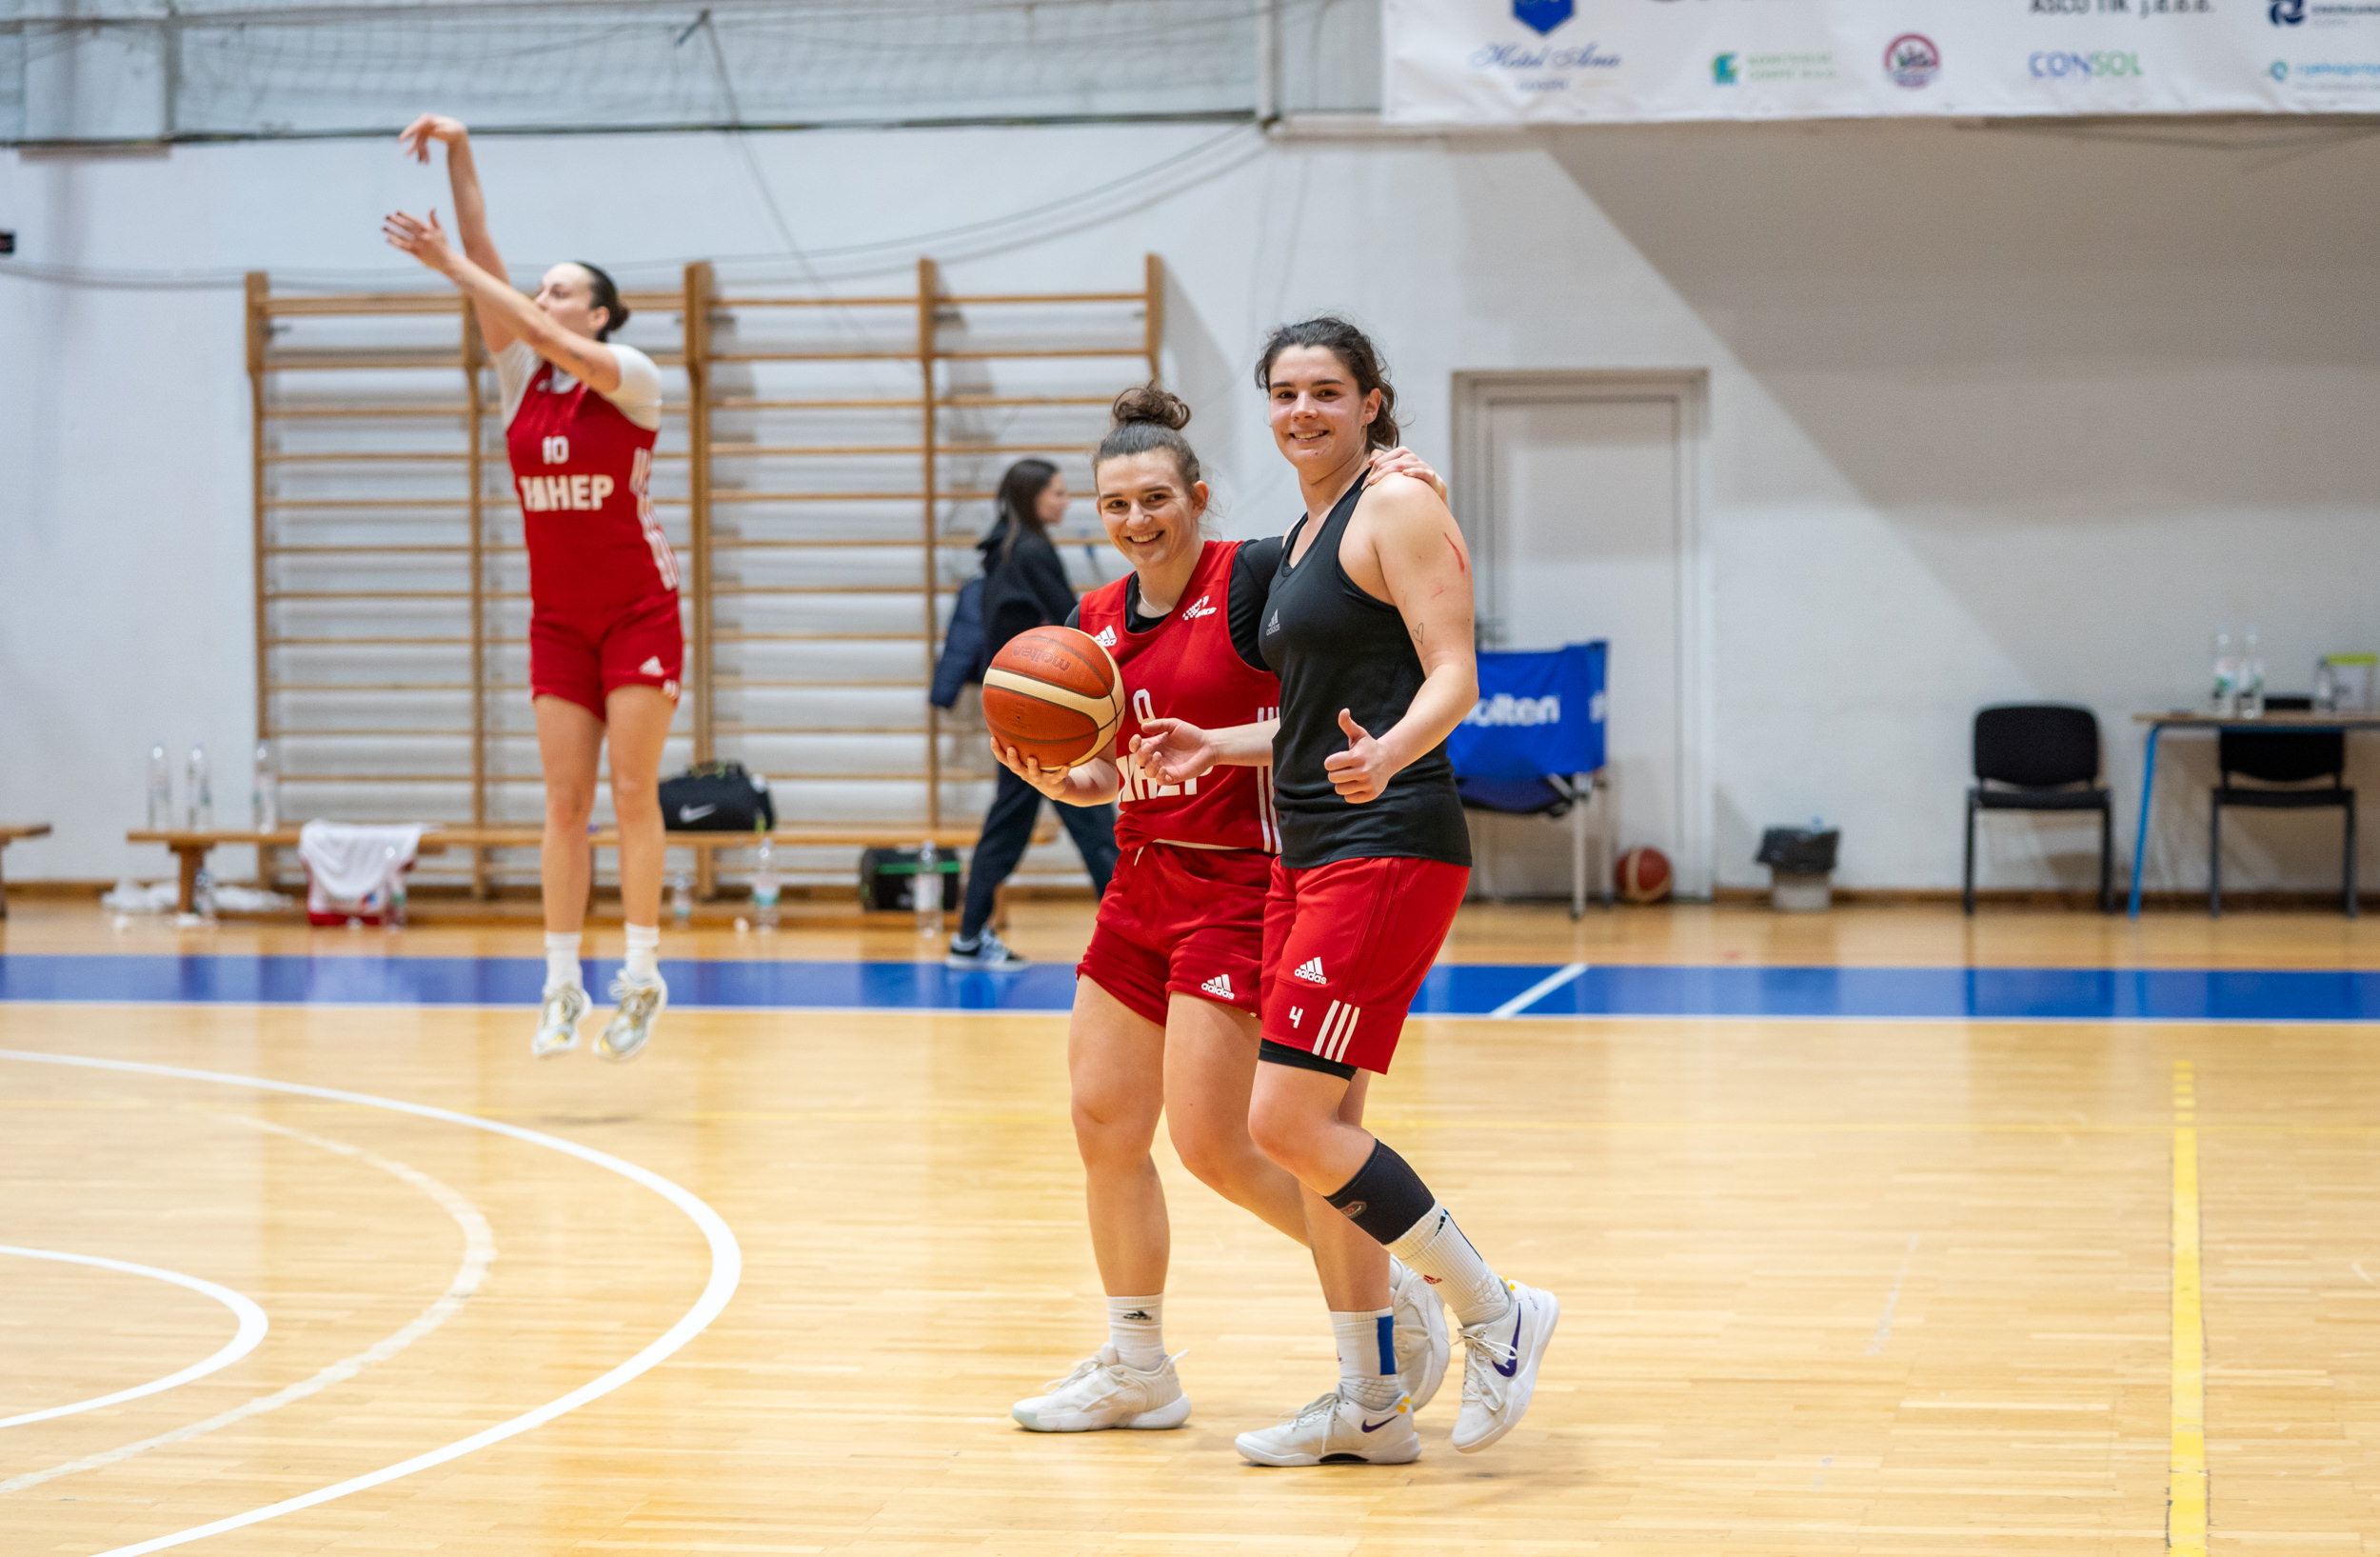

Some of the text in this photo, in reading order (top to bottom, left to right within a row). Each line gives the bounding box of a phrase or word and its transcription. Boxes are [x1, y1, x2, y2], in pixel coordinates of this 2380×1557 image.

[2029, 51, 2143, 77] CONSOL
[542, 435, 569, 465] 10
[1012, 646, 1072, 671] molten
[1294, 967, 1327, 985] adidas
[1200, 981, 1235, 1000] adidas
[1289, 1006, 1304, 1028] 4
